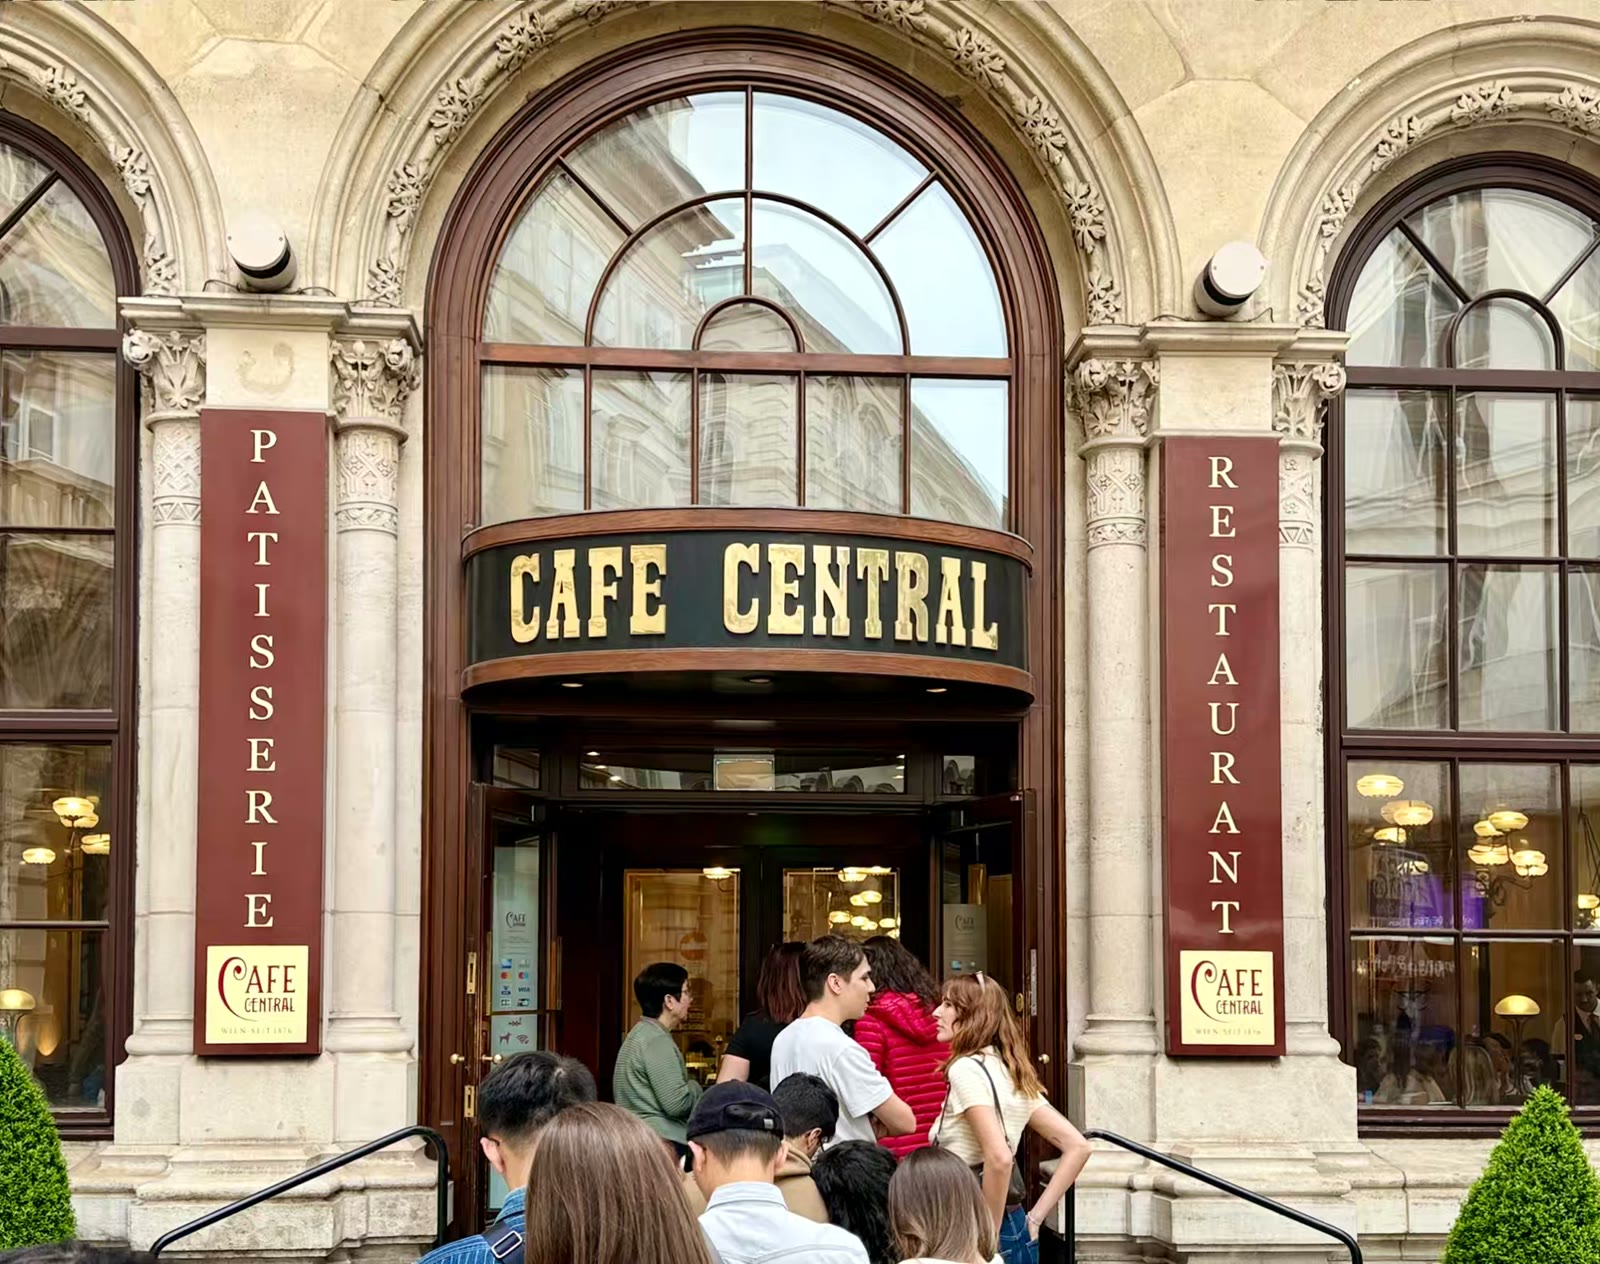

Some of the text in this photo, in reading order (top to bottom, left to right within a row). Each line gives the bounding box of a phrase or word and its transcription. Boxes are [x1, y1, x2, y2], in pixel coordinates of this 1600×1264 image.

[509, 542, 999, 651] CAFE CENTRAL
[243, 429, 280, 928] PATISSERIE
[1206, 456, 1242, 934] RESTAURANT
[218, 956, 296, 1022] CAFE
[244, 997, 296, 1013] CENTRAL
[1191, 960, 1263, 1023] CAFE
[1215, 999, 1264, 1015] CENTRAL
